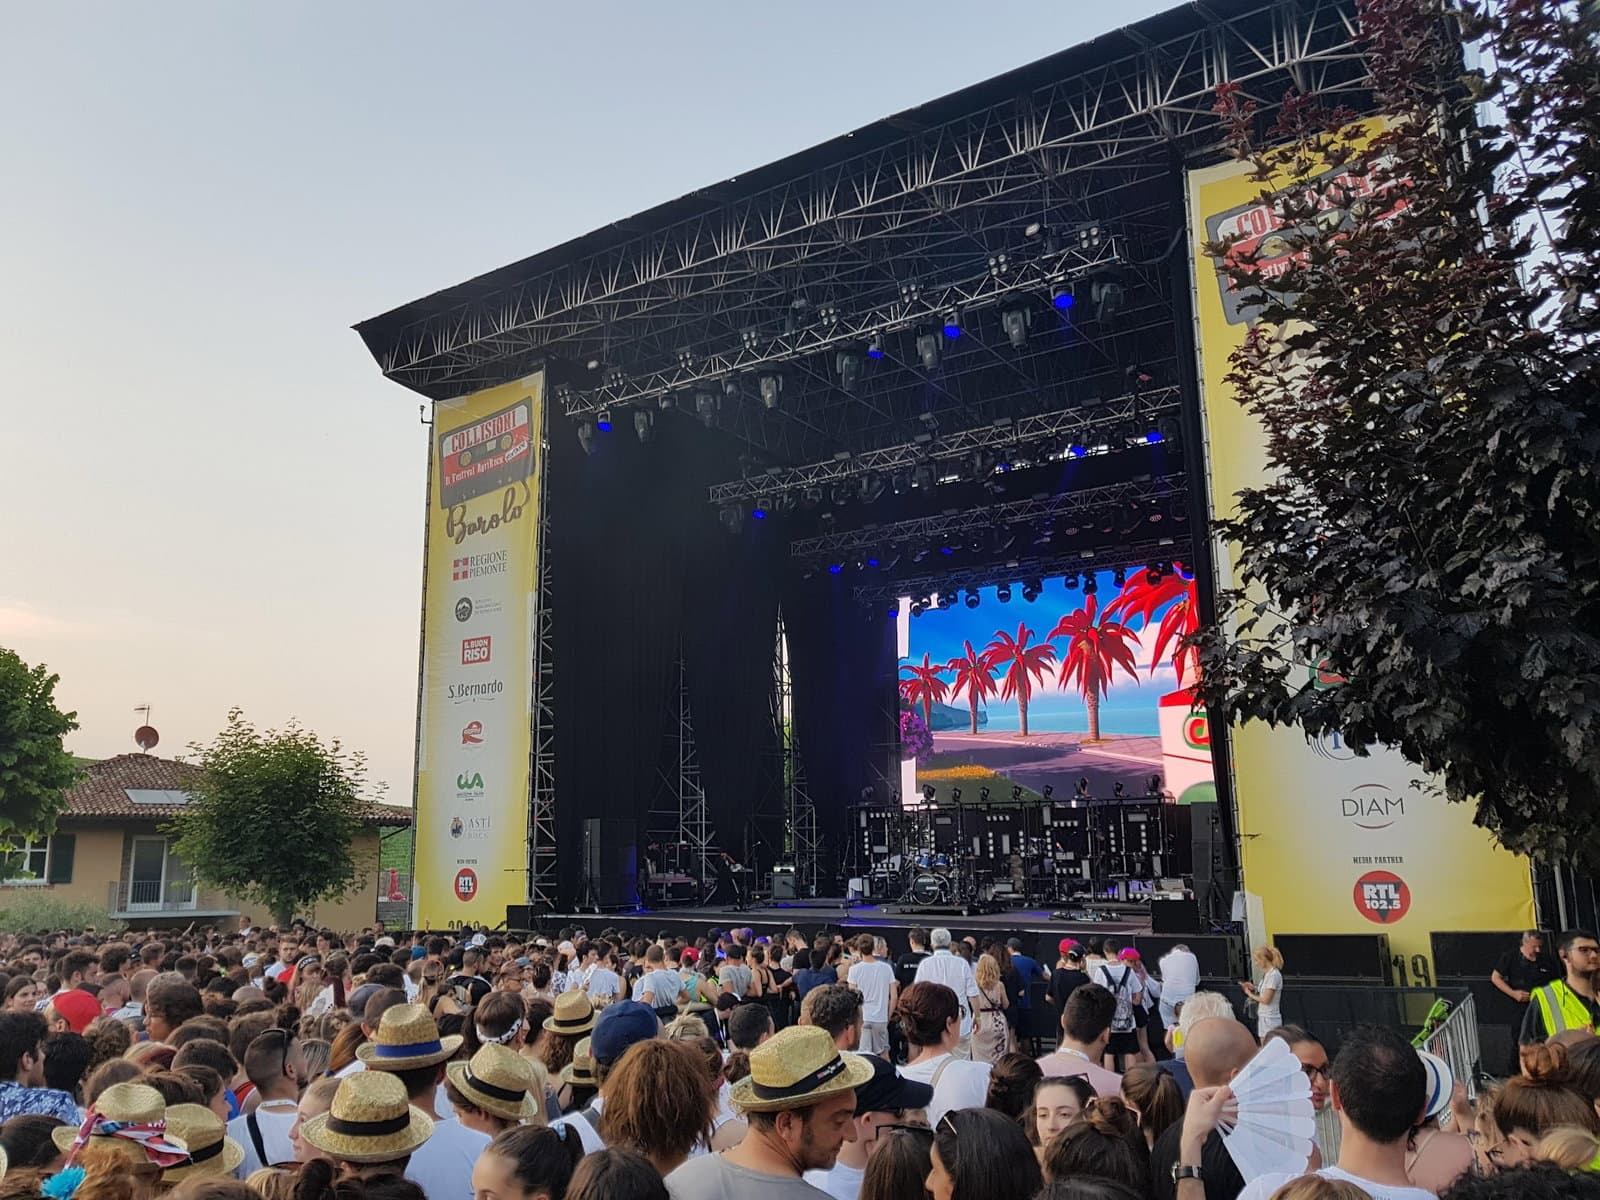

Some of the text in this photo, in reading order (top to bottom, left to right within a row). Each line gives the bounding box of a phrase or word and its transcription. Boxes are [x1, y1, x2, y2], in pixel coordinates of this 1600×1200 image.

[451, 411, 517, 452] COLLISIONI
[452, 465, 475, 483] Festival
[446, 484, 527, 545] Barolo
[470, 550, 508, 567] REGIONE
[469, 562, 507, 578] PIEMONTE
[470, 639, 489, 648] BUON
[464, 647, 488, 661] RISO
[1341, 797, 1405, 817] DIAM
[1374, 856, 1403, 864] PARTNER
[458, 876, 474, 886] RTL
[1362, 884, 1400, 899] RTL
[1364, 899, 1401, 910] 102.5
